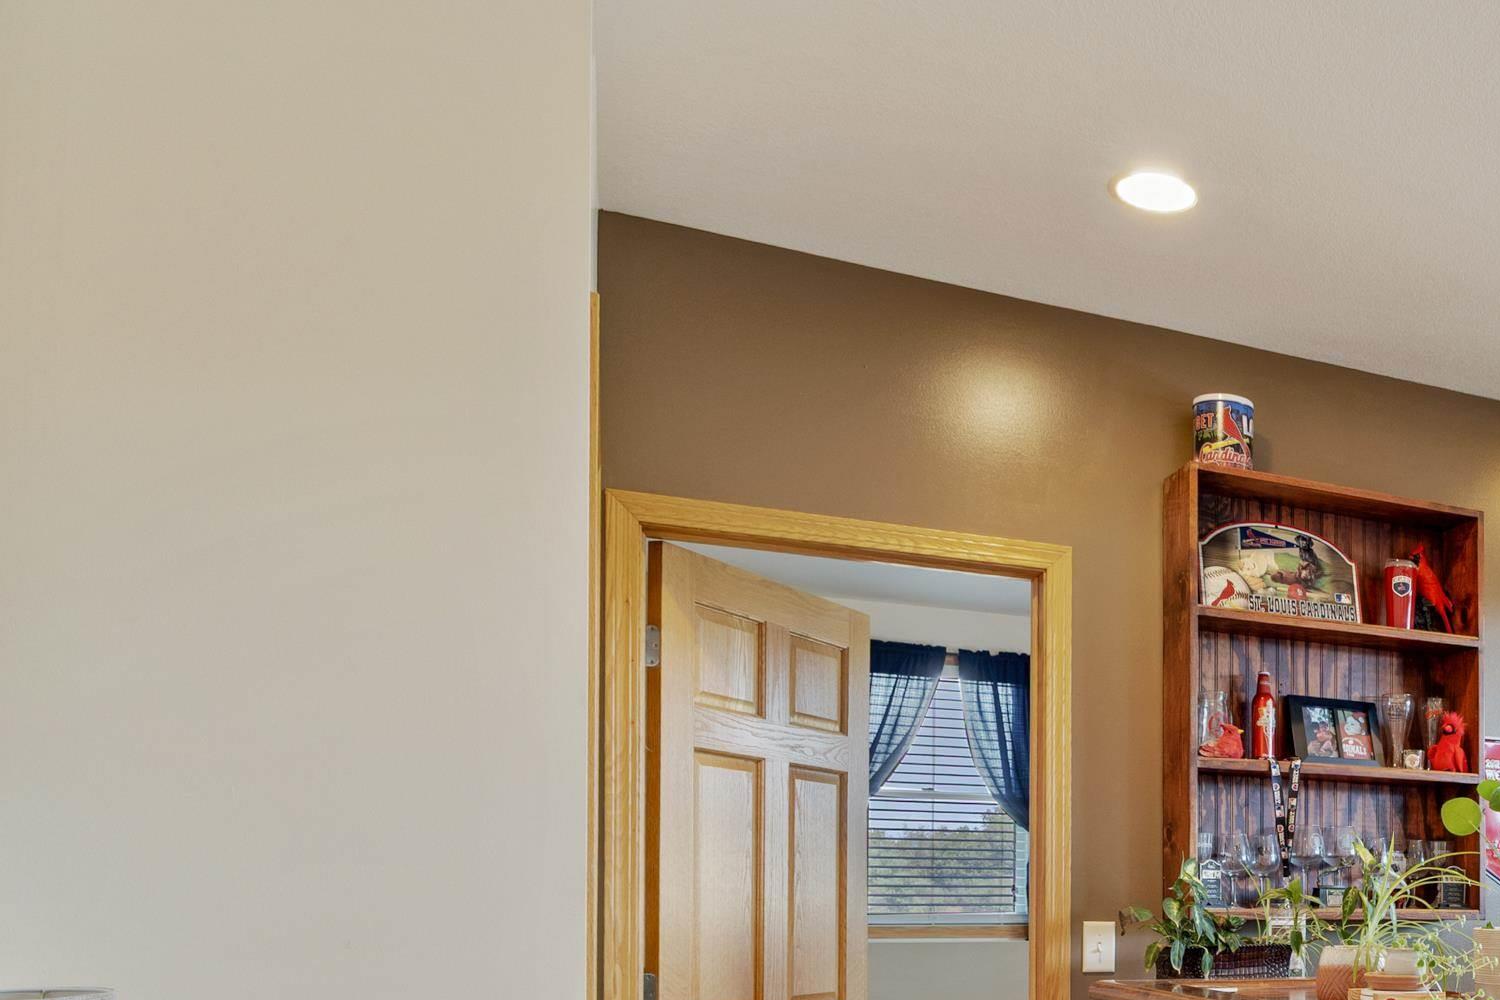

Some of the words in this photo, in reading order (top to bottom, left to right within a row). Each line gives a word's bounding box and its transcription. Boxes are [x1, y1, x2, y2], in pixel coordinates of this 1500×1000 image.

[1249, 595, 1265, 612] ST.
[1267, 597, 1297, 616] LOUIS
[1300, 600, 1358, 622] CARDINALS
